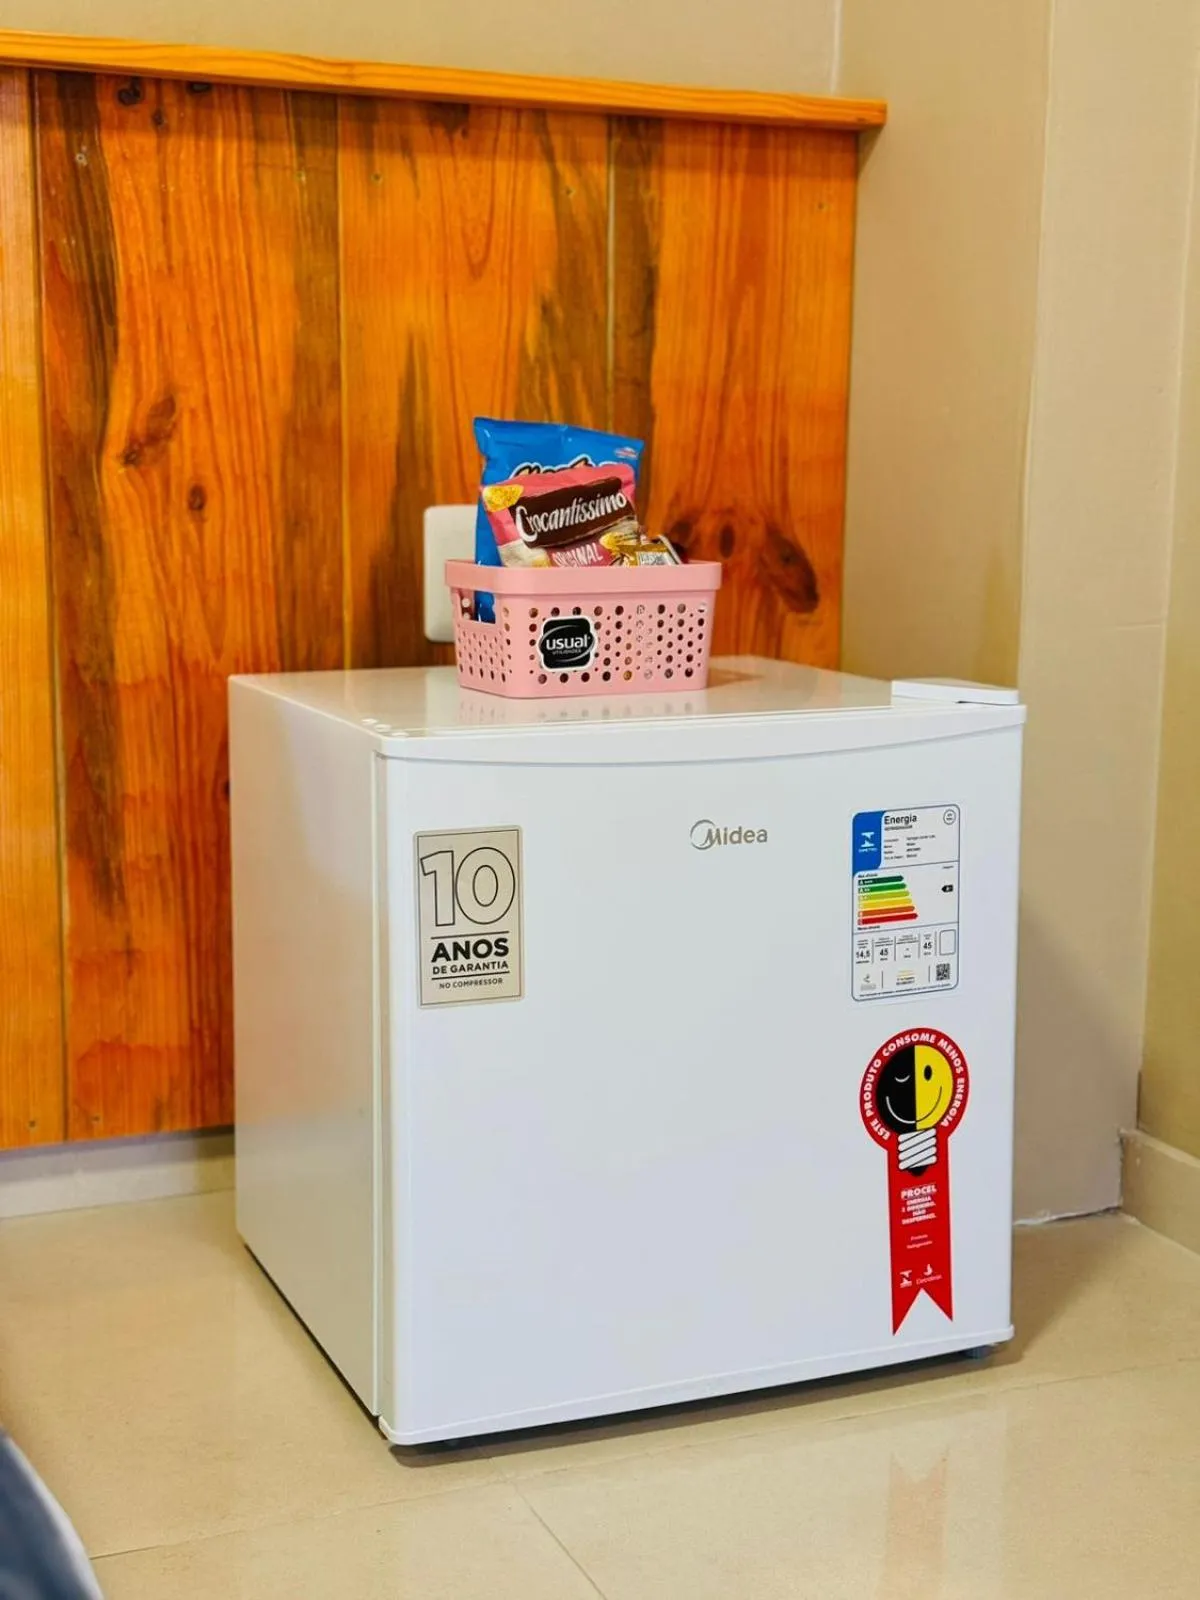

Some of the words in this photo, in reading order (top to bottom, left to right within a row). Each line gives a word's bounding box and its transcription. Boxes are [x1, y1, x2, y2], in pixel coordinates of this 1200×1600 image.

[515, 491, 628, 543] Crocantíssimo
[546, 633, 588, 650] usual
[884, 814, 918, 826] Energia
[690, 819, 768, 850] Midea
[420, 846, 516, 927] 10
[431, 937, 509, 963] ANOS
[879, 948, 889, 956] 45
[923, 942, 932, 950] 45
[432, 966, 448, 975] DE
[450, 961, 509, 974] GARANTIA
[439, 982, 451, 990] NO
[453, 978, 503, 989] COMPRESSOR
[882, 1033, 937, 1057] CONSOME
[937, 1038, 964, 1074] MENOS
[863, 1059, 882, 1118] PRODUTO
[940, 1077, 965, 1128] ENERGIA
[870, 1119, 891, 1141] ESTE
[901, 1184, 937, 1199] PROCEL
